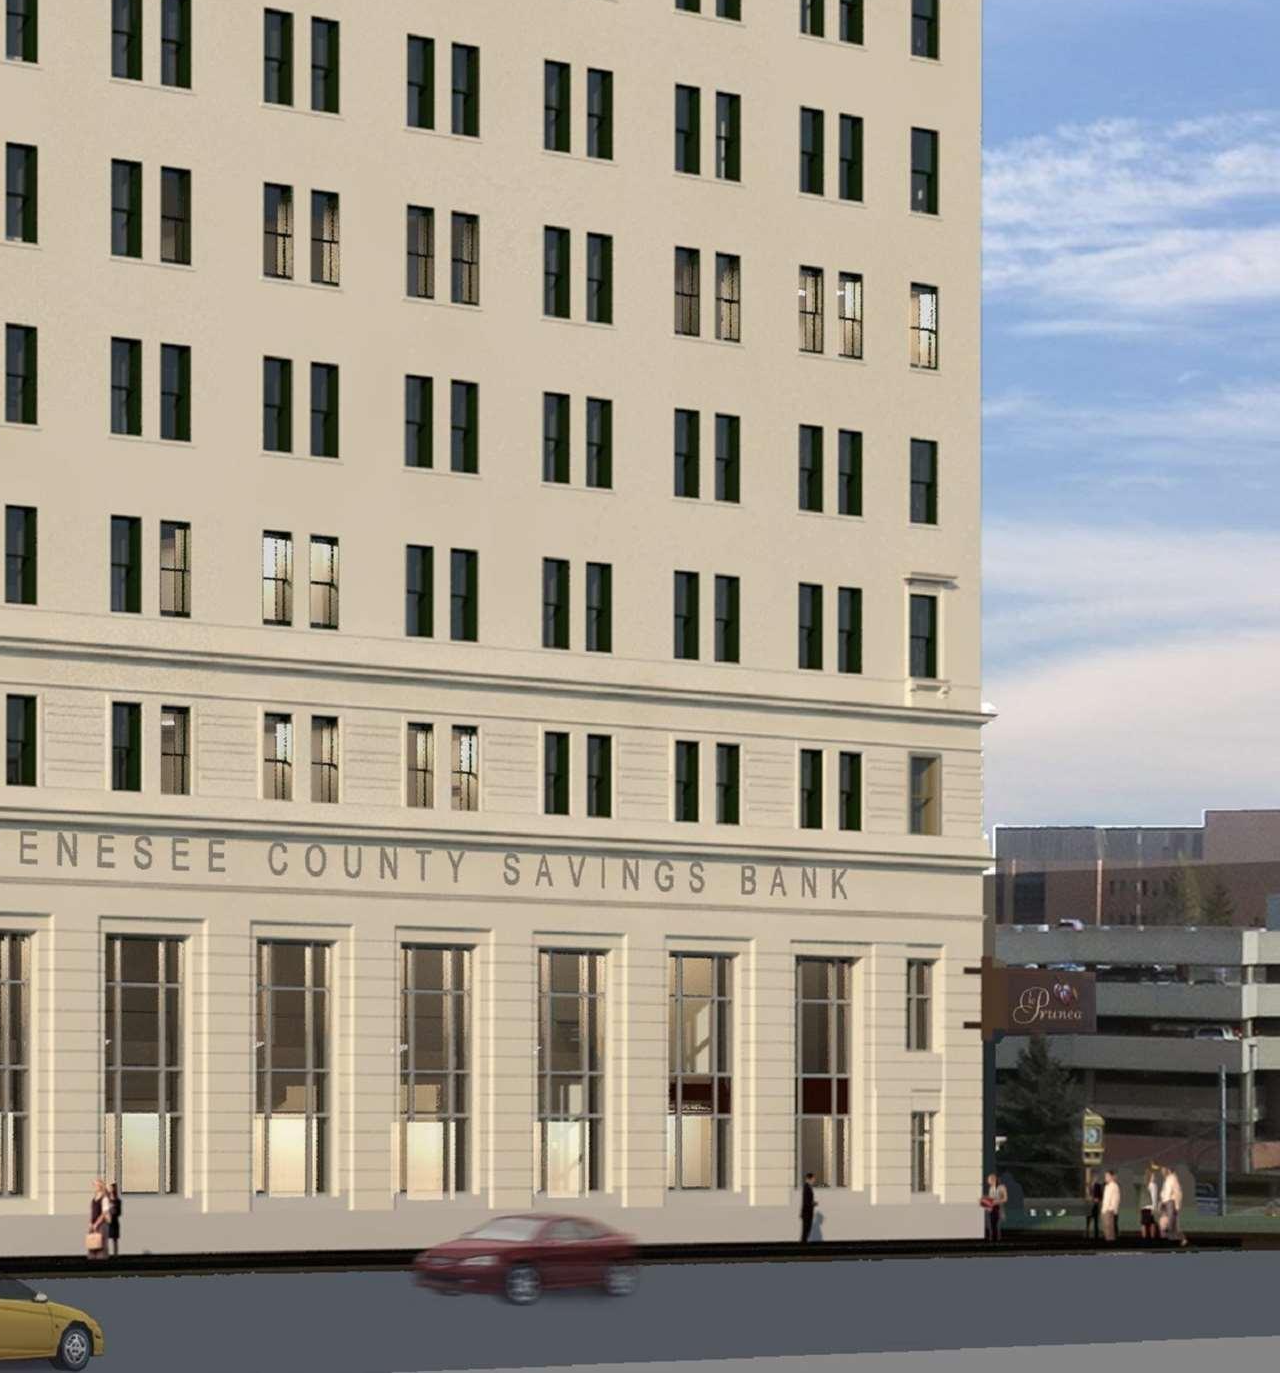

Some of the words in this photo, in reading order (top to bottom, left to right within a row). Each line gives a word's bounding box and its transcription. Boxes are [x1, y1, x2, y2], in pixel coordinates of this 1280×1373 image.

[267, 841, 466, 884] COUNTY
[503, 851, 706, 894] SAVINGS
[740, 864, 849, 900] BANK
